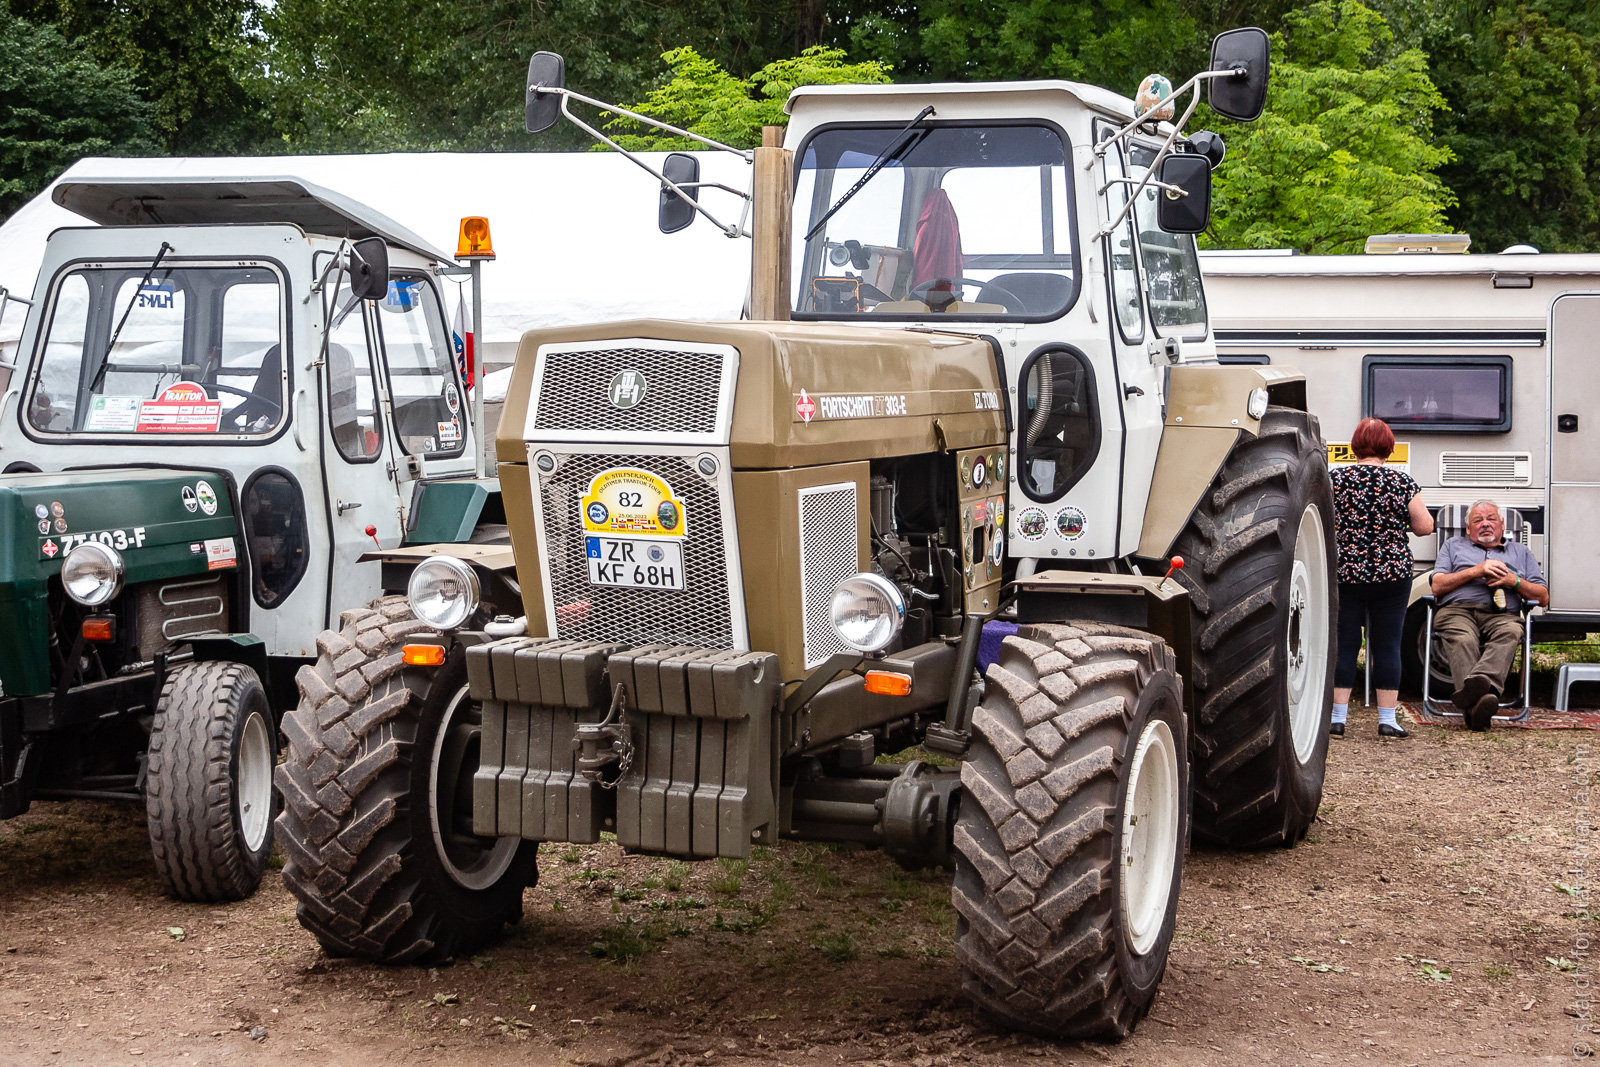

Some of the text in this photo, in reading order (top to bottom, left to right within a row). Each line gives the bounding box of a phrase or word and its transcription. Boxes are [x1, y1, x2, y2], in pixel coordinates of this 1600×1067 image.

[164, 390, 203, 400] TRAKTOR
[820, 396, 874, 418] FORTSCHRITT
[884, 395, 907, 416] 303-E
[618, 492, 643, 508] 82
[606, 541, 635, 562] ZR
[597, 562, 675, 587] KF 68H
